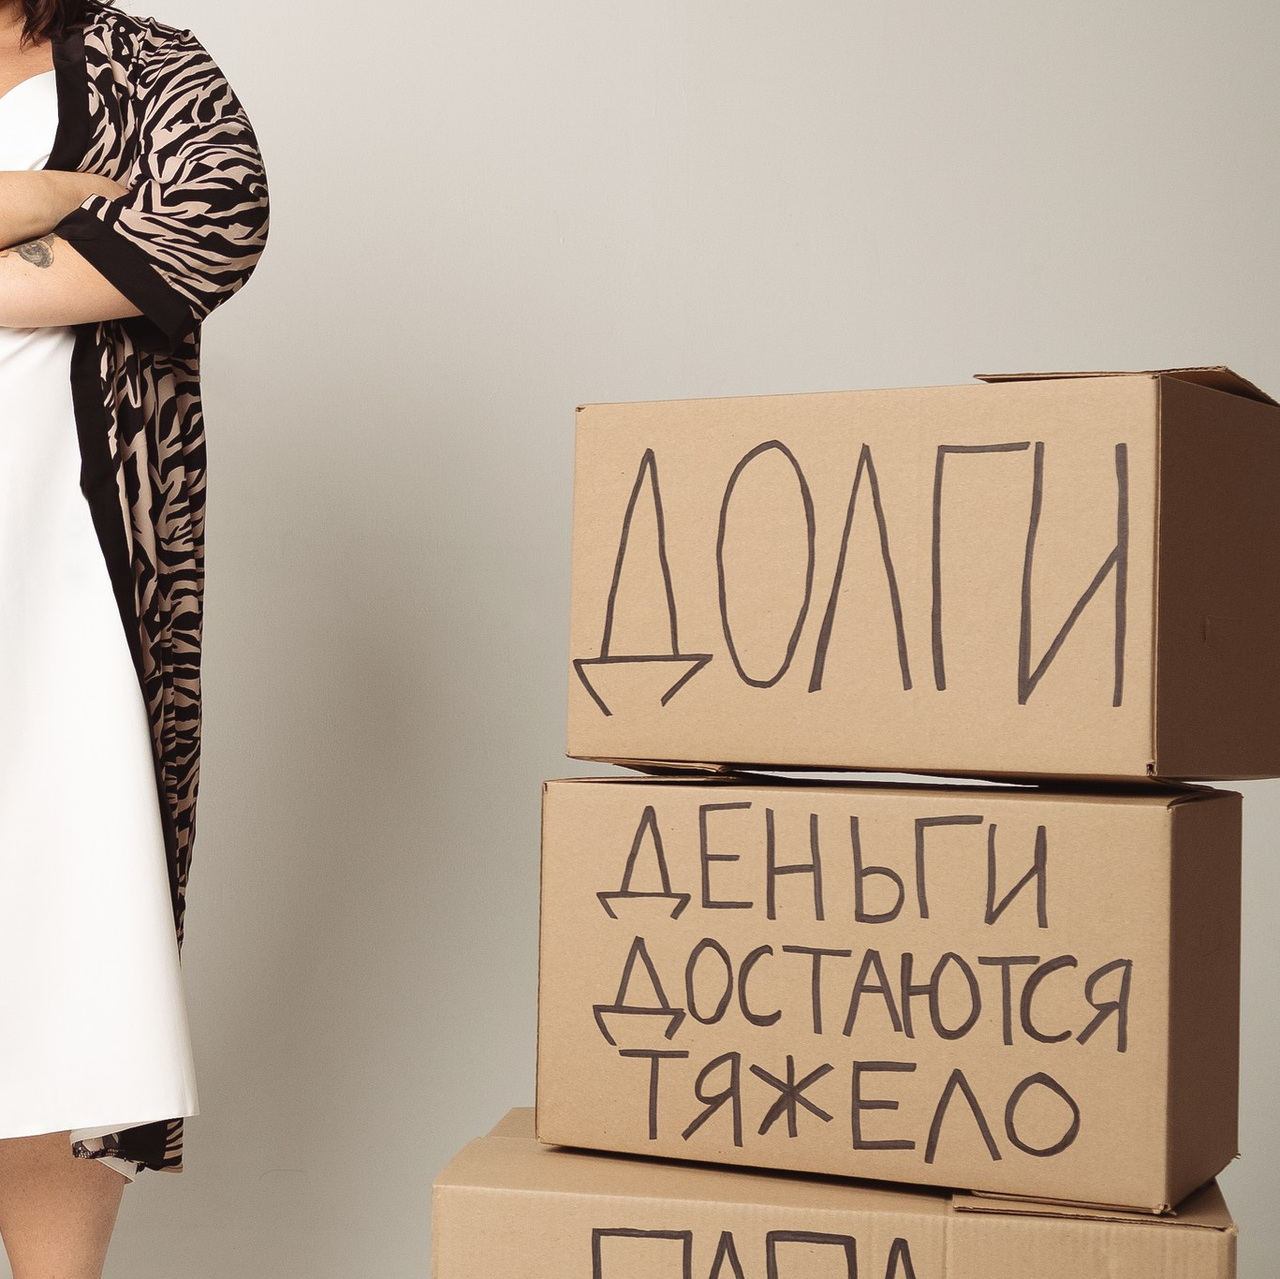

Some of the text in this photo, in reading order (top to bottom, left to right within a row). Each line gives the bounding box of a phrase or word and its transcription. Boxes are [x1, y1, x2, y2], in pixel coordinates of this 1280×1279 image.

[573, 440, 1128, 716] ДОЛГИ
[596, 801, 1048, 929] ДЕНЬГИ
[593, 936, 1132, 1053] ДОСТАЮТСЯ
[619, 1049, 1080, 1164] ТЯЖЕЛО
